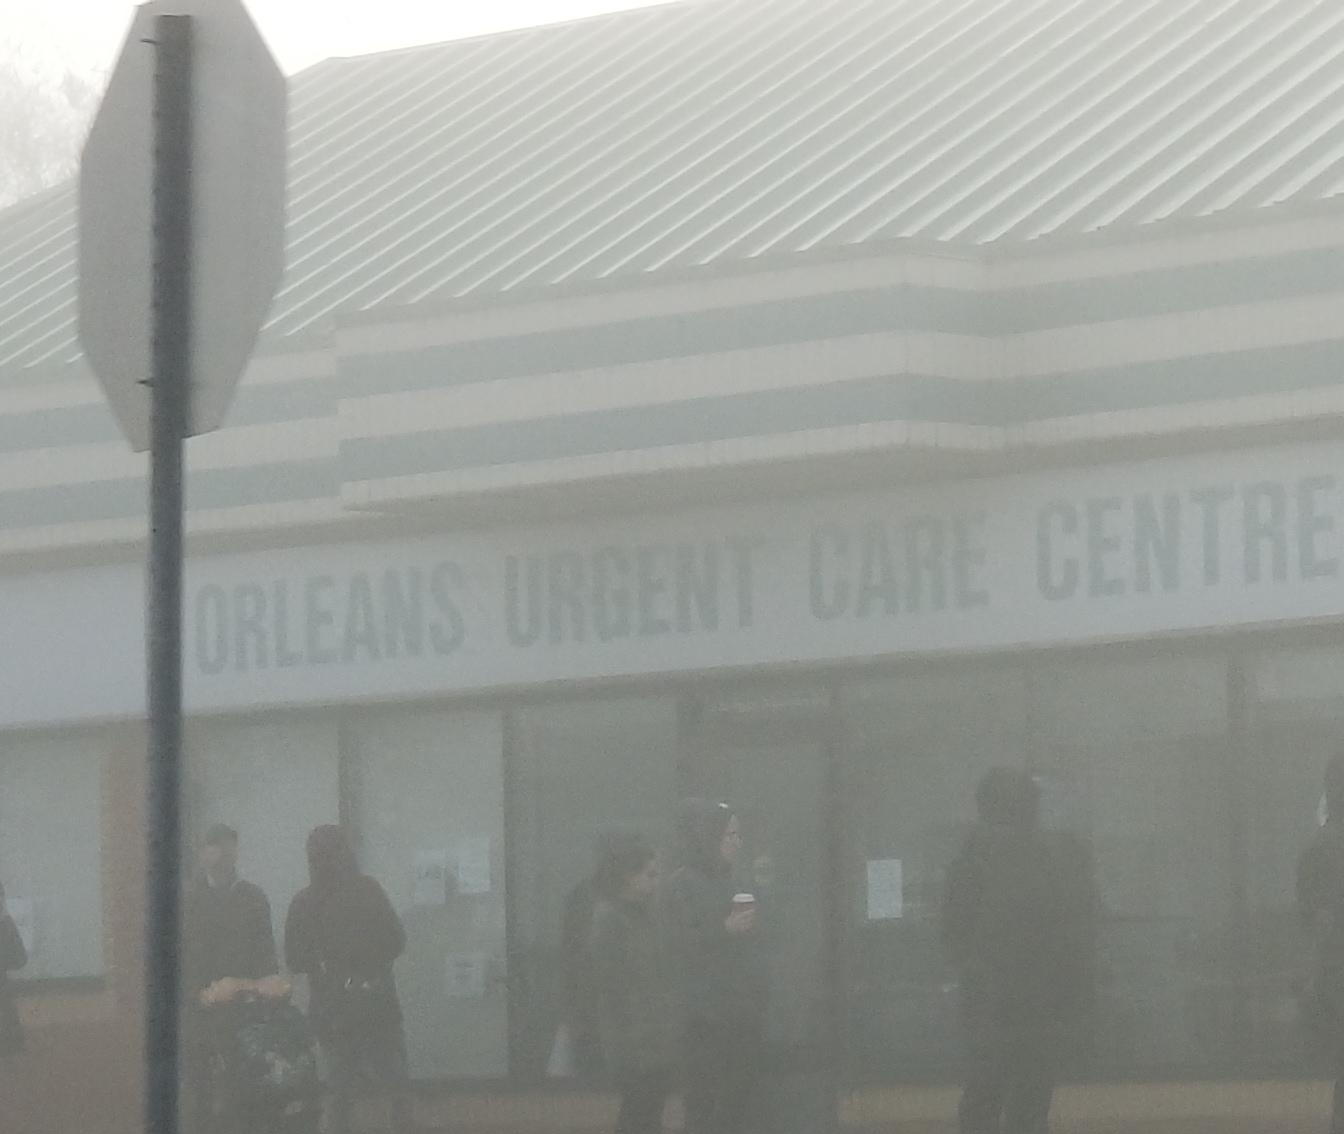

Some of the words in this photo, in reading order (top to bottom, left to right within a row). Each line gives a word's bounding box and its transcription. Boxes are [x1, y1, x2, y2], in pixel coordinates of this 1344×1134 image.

[196, 559, 465, 675] ORLEANS
[505, 536, 762, 648] URGENT
[810, 512, 990, 621] CARE
[1035, 474, 1339, 601] CENTRE
